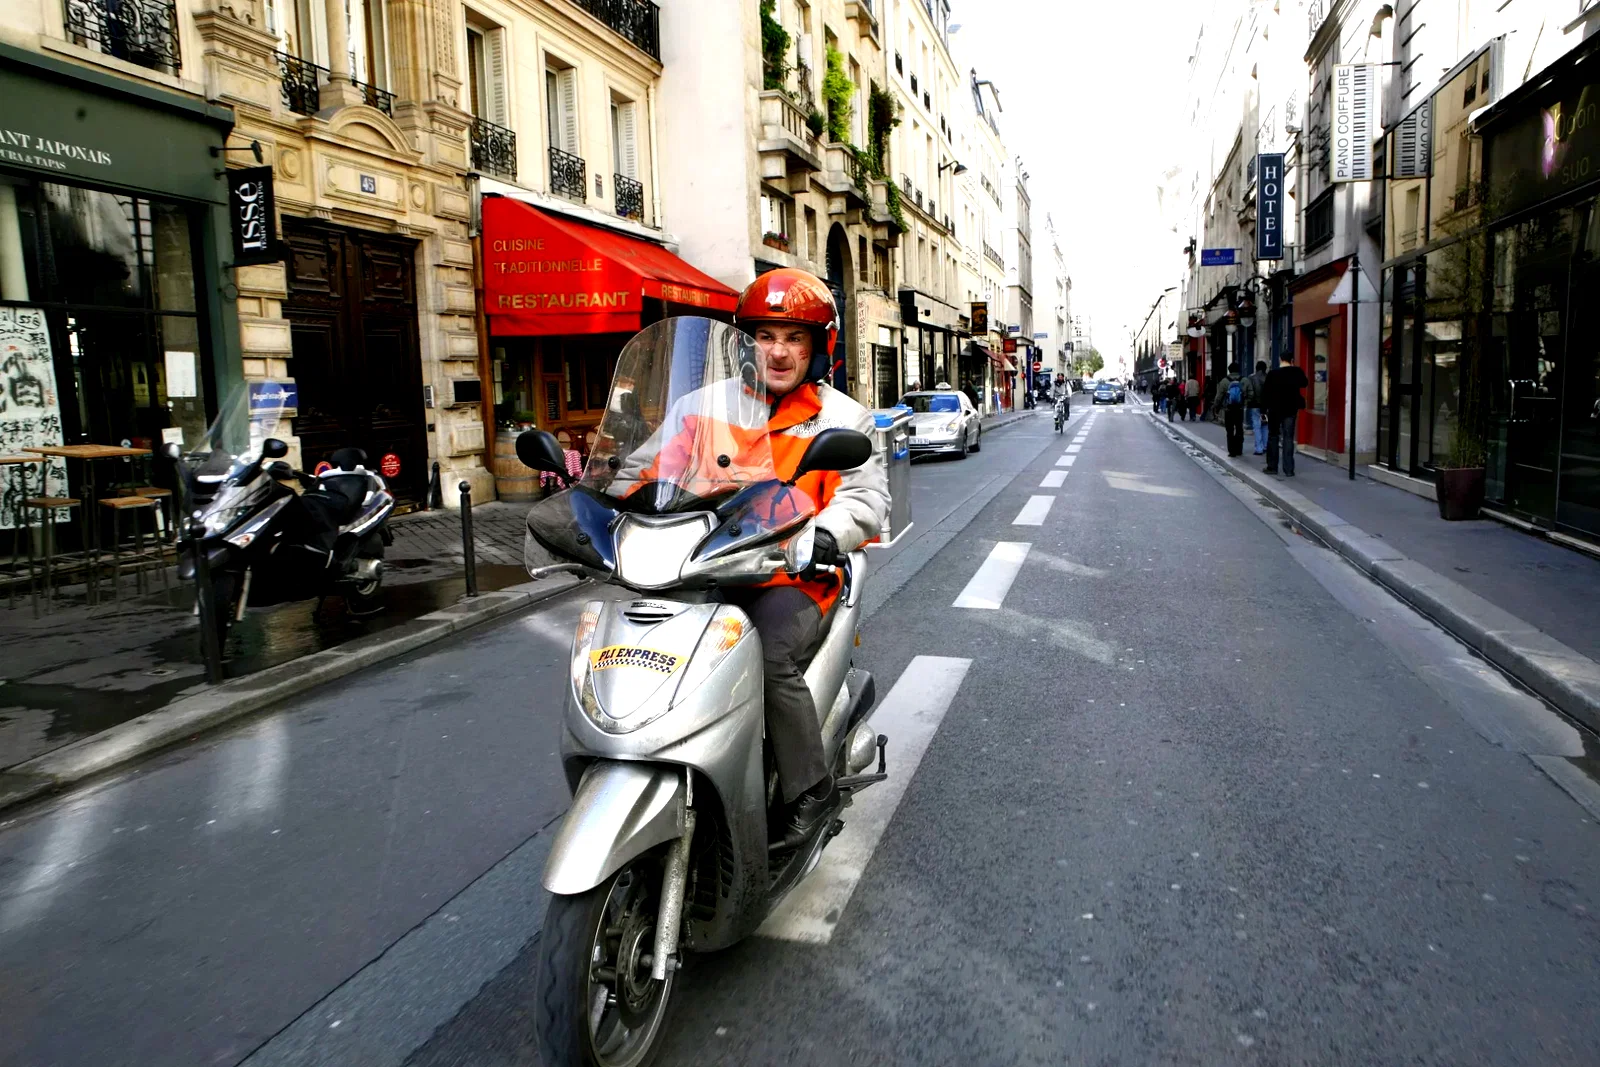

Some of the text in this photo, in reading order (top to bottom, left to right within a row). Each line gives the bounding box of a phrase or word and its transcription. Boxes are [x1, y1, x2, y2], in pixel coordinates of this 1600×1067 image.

[1337, 68, 1350, 178] PIANO COIFFURE
[36, 137, 112, 165] JAPONAIS
[33, 155, 67, 169] TAPAS
[362, 177, 375, 192] 45
[1264, 166, 1278, 247] HOTEL
[493, 239, 545, 252] CUISINE
[494, 258, 603, 274] TRADITIONNELLE
[498, 292, 630, 309] RESTAURANT
[661, 284, 710, 306] RESTAURANT
[598, 648, 677, 666] PLI EXPRESS
